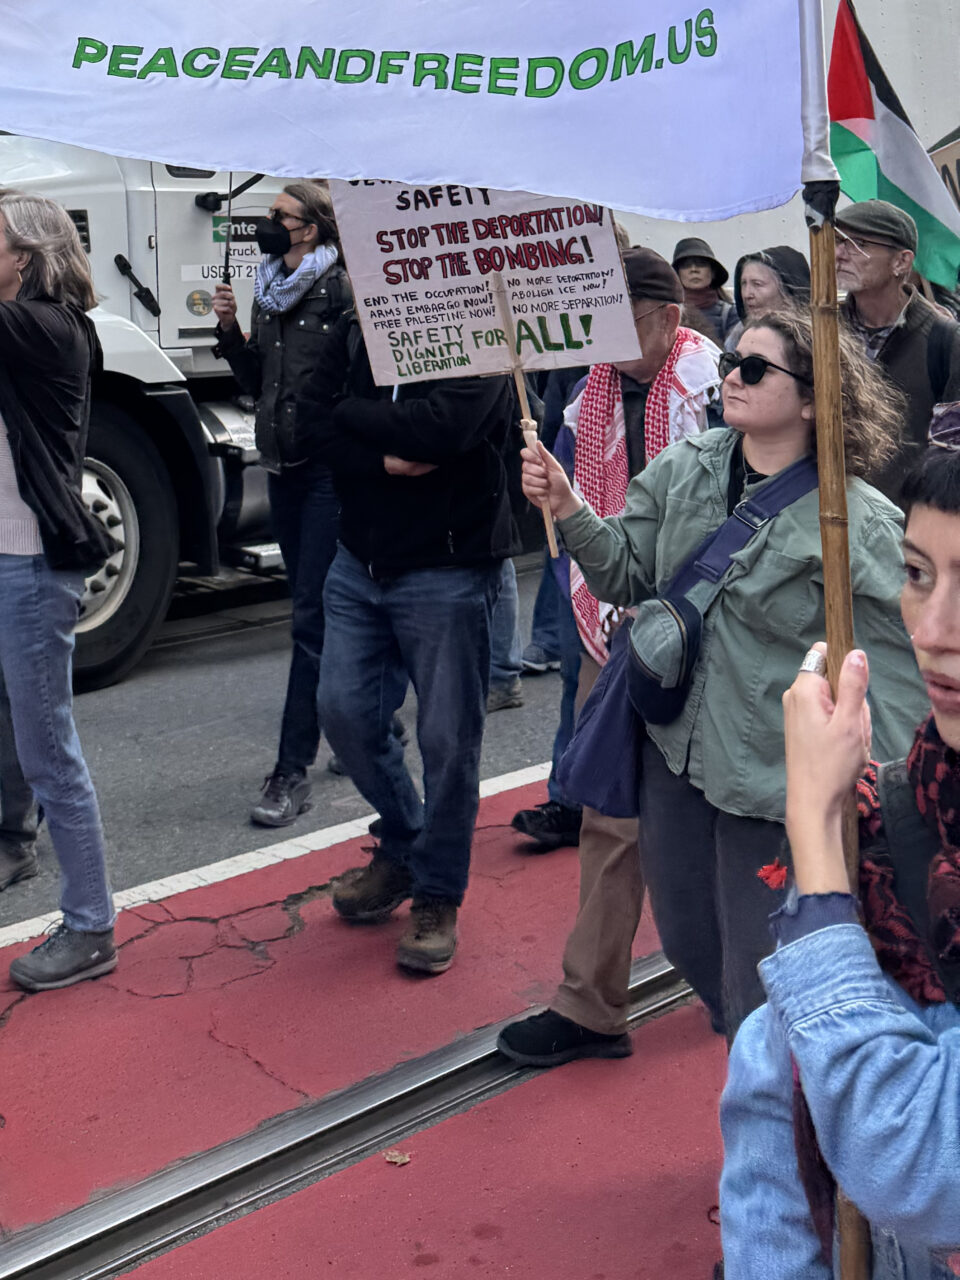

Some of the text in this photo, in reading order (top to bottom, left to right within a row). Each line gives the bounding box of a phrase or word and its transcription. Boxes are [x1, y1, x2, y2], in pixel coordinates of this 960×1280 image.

[71, 8, 718, 98] PEACEANDFREEDOM.US
[376, 226, 430, 253] STOP
[431, 221, 470, 246] THE
[383, 235, 594, 285] STOP THE BOMBING!
[364, 281, 490, 307] END THE OCCUPATION!
[507, 278, 521, 288] NO
[526, 275, 552, 286] MORE
[511, 289, 554, 300] ABOLISH
[558, 285, 577, 294] ICE
[370, 293, 493, 319] ARMS EMBARGO NOW!
[512, 293, 623, 314] NO MORE SEPARATION!
[374, 305, 496, 331] FREE PALESTINE NOW!
[388, 313, 593, 356] SAFETY FOR ALL!
[392, 340, 464, 363] DIGNITY
[397, 353, 472, 377] LIBERATION
